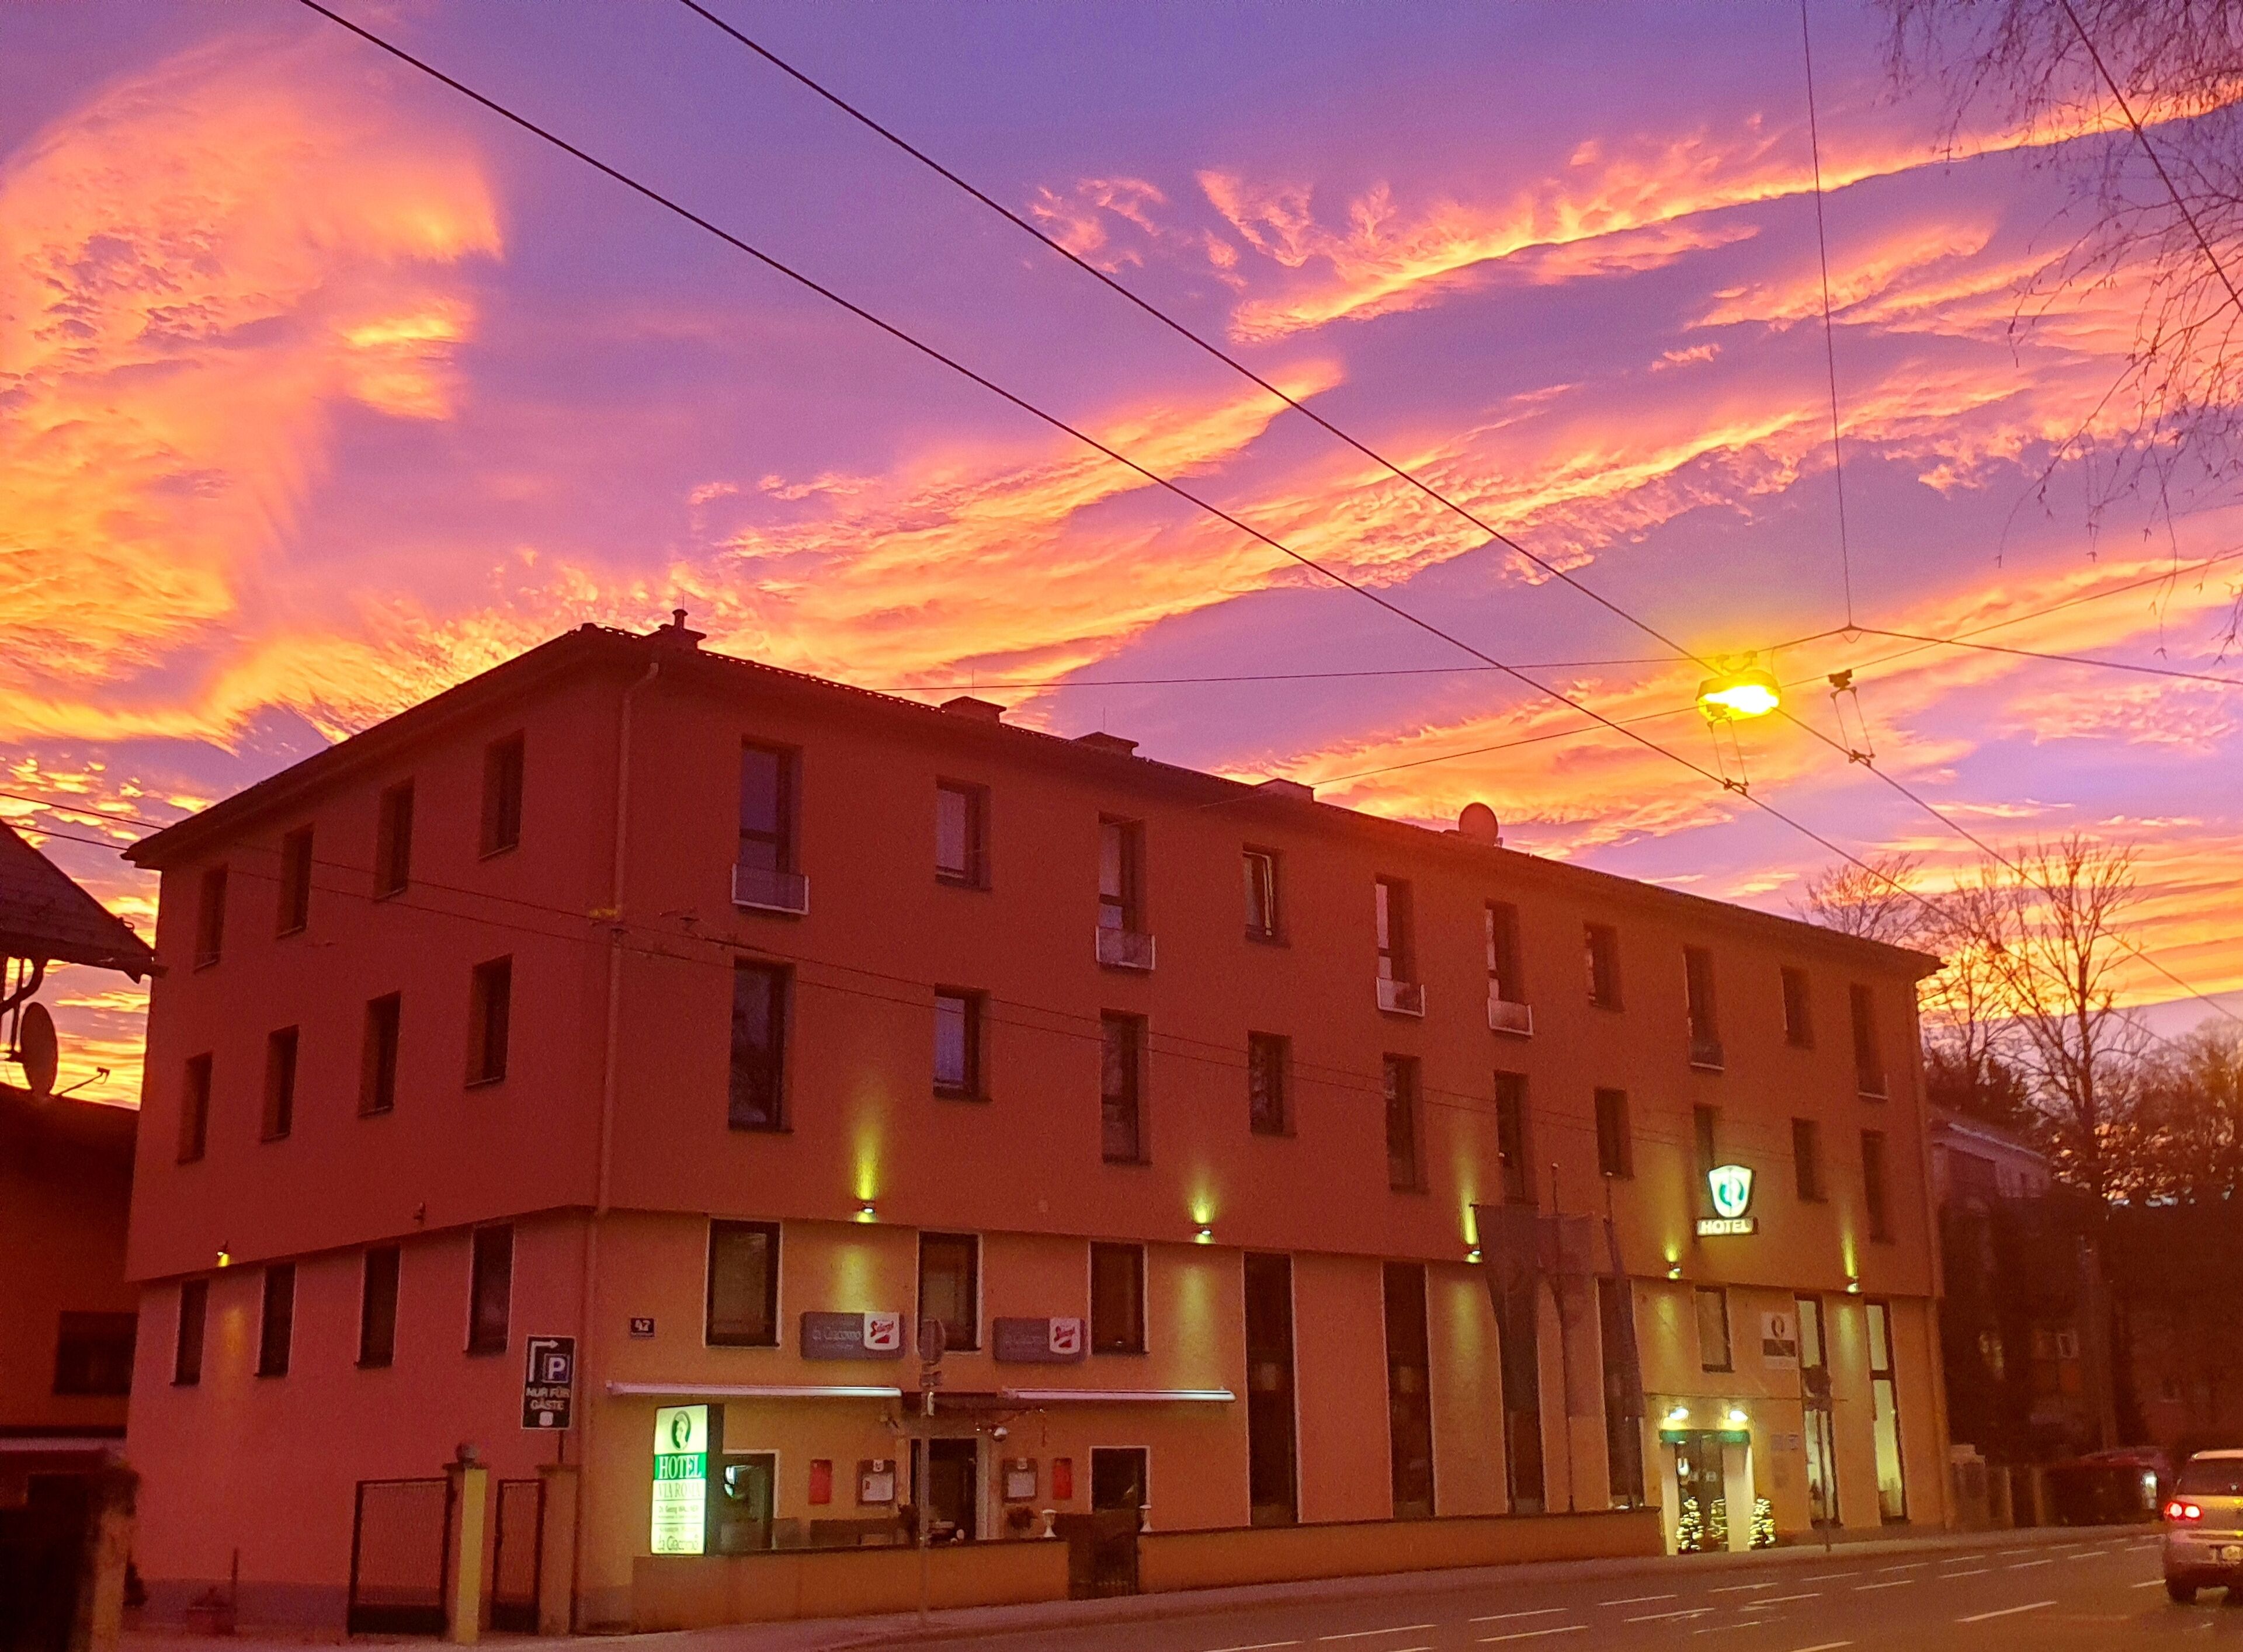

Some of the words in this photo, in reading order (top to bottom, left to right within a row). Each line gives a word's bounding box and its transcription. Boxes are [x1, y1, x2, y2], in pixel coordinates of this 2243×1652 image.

[1699, 1219, 1751, 1234] HOTEL
[548, 1357, 566, 1380] P
[526, 1387, 548, 1397] NUR
[658, 1454, 702, 1479] HOTEL
